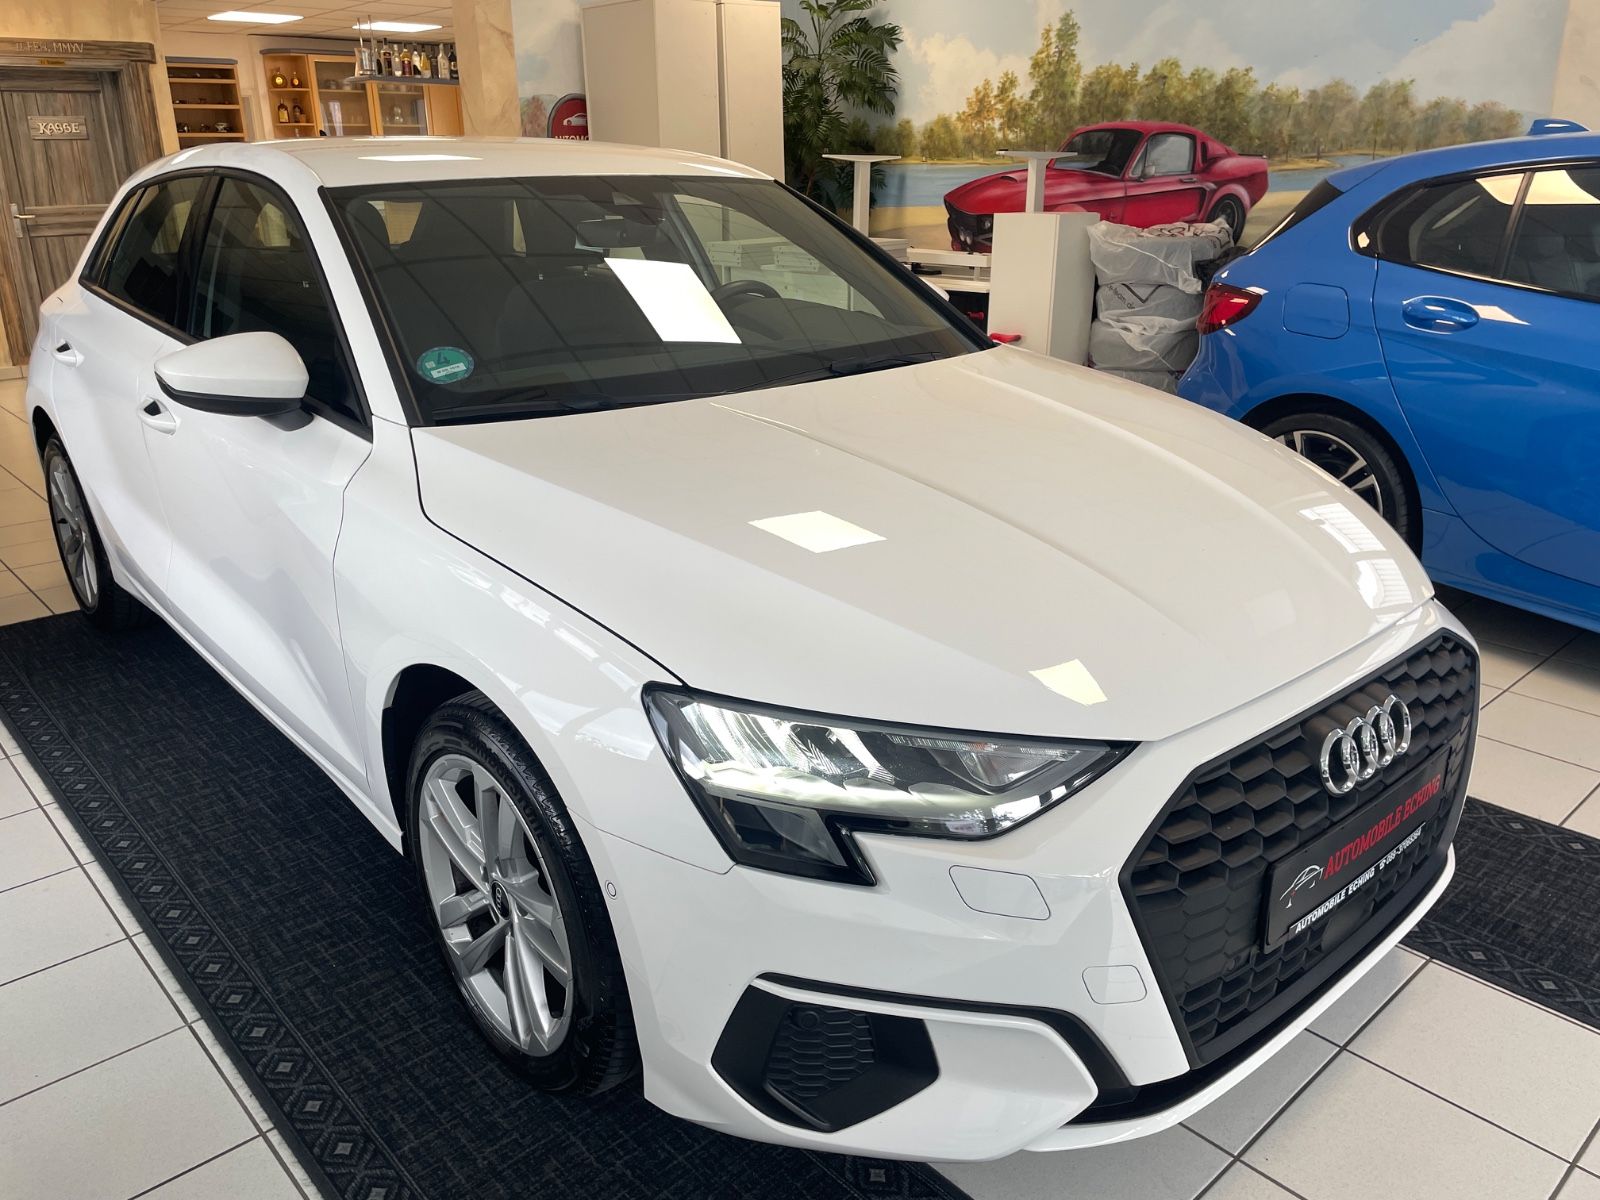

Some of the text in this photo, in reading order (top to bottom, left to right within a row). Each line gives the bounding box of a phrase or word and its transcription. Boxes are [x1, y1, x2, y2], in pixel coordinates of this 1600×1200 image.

[37, 122, 80, 136] KASSE
[1323, 806, 1403, 880] AUTOMOBILE
[1403, 774, 1441, 820] ECHING
[1295, 867, 1375, 934] AUTOMOBILE ECHING
